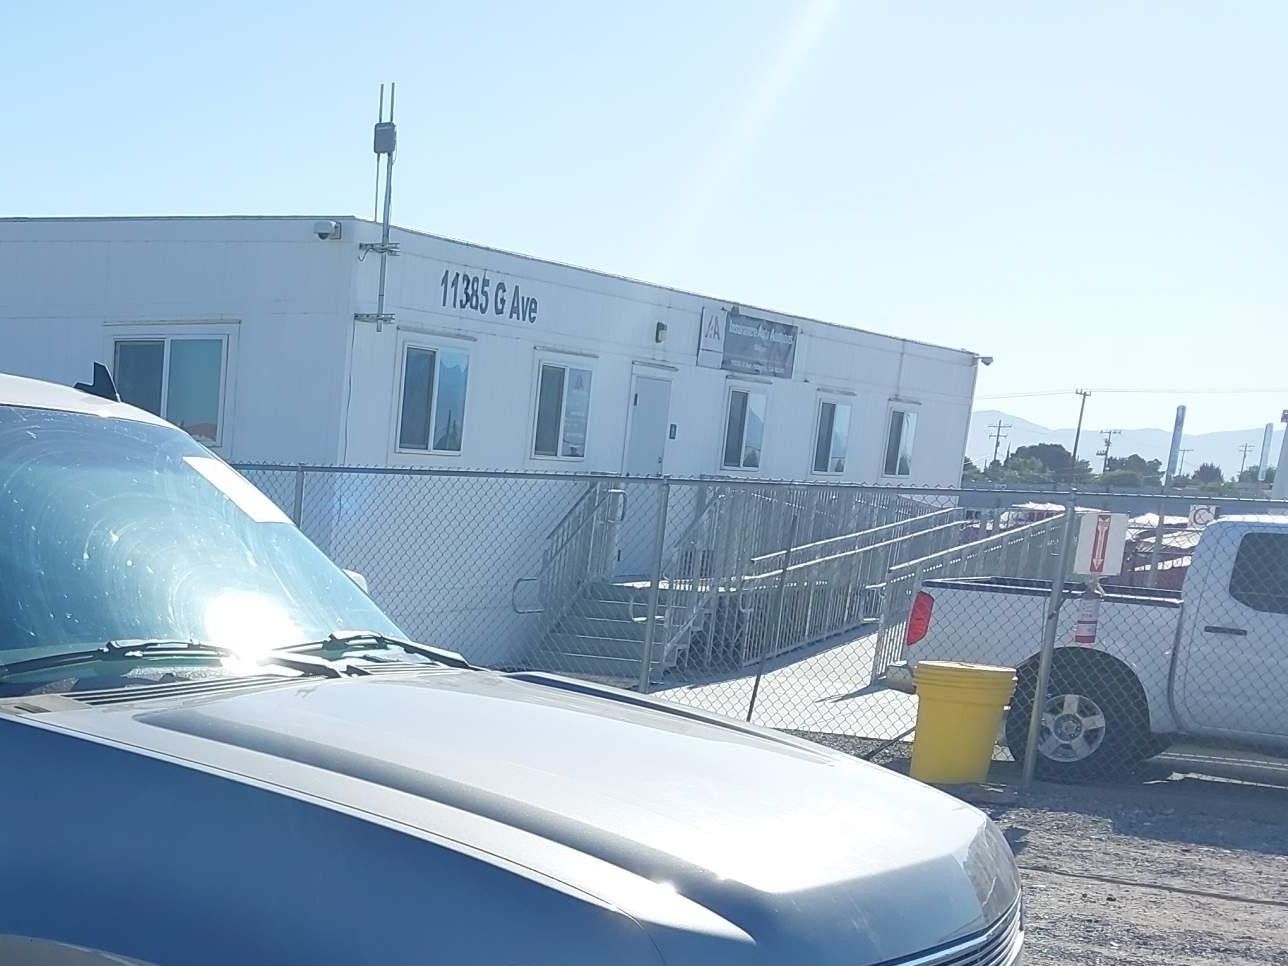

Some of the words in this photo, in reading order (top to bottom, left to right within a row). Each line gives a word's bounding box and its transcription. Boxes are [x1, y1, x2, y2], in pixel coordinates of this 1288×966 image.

[440, 269, 490, 314] 11385
[494, 281, 506, 315] G
[509, 284, 538, 324] Ave
